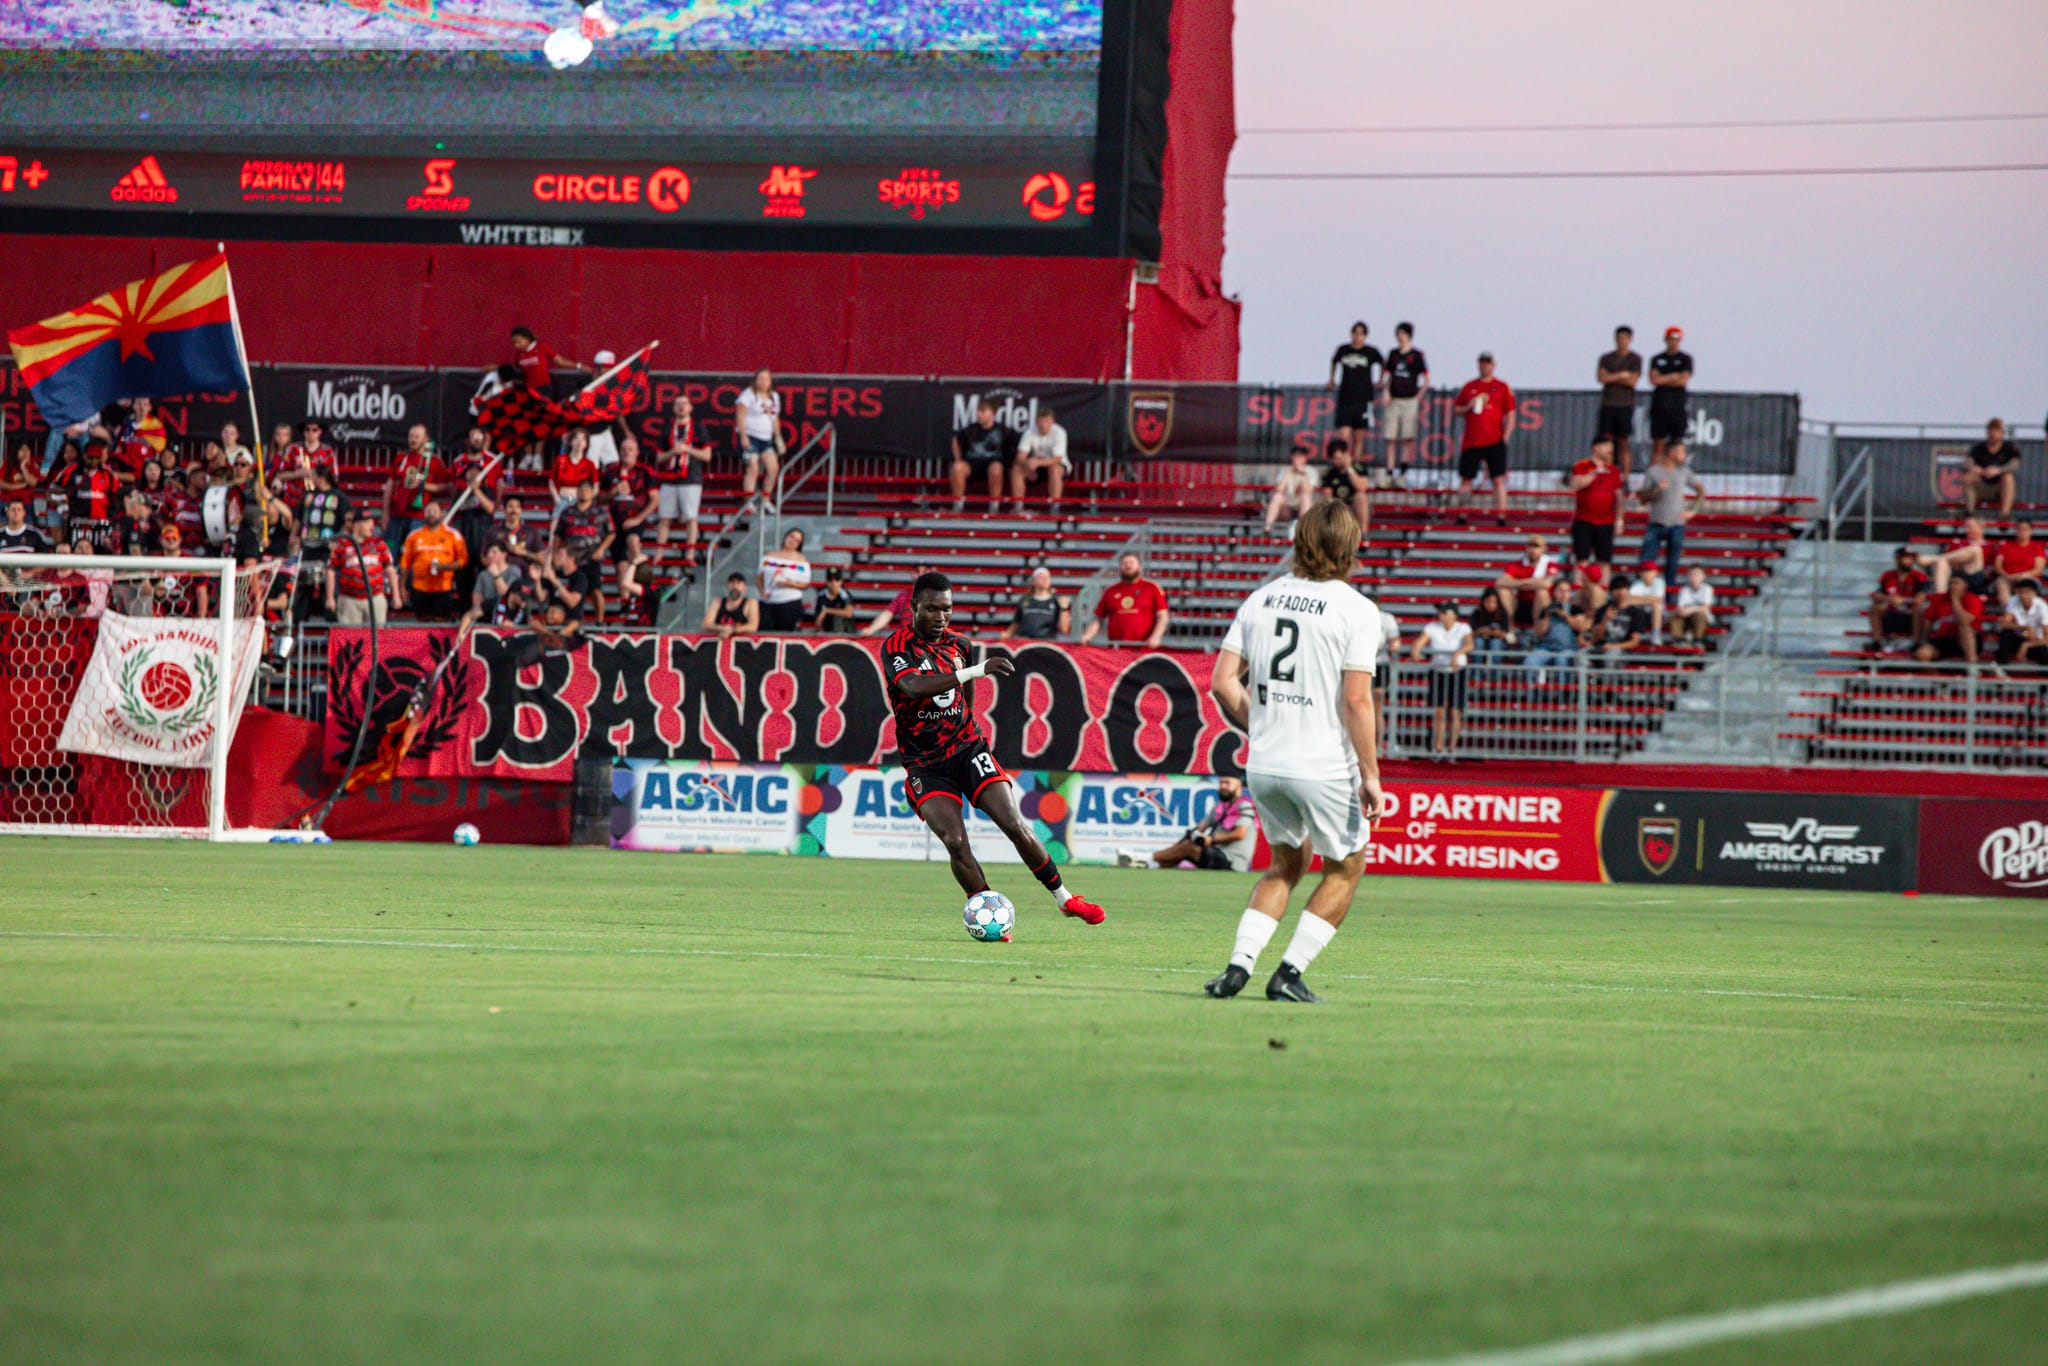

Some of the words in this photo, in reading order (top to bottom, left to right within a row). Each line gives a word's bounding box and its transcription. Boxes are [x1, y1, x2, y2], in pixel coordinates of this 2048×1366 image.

[240, 173, 315, 191] FAMILY
[532, 173, 641, 202] CIRCLE
[878, 178, 960, 202] SPORTS
[307, 379, 406, 420] Modelo
[1270, 617, 1299, 682] 2
[1272, 692, 1313, 706] TOYOTA
[971, 752, 997, 777] 13
[640, 772, 790, 814] ASMC
[1409, 793, 1562, 823] PARTNER
[1406, 821, 1437, 839] OF
[1446, 845, 1560, 871] RISING
[1719, 841, 1817, 862] AMERICA
[1819, 844, 1885, 865] FIRST
